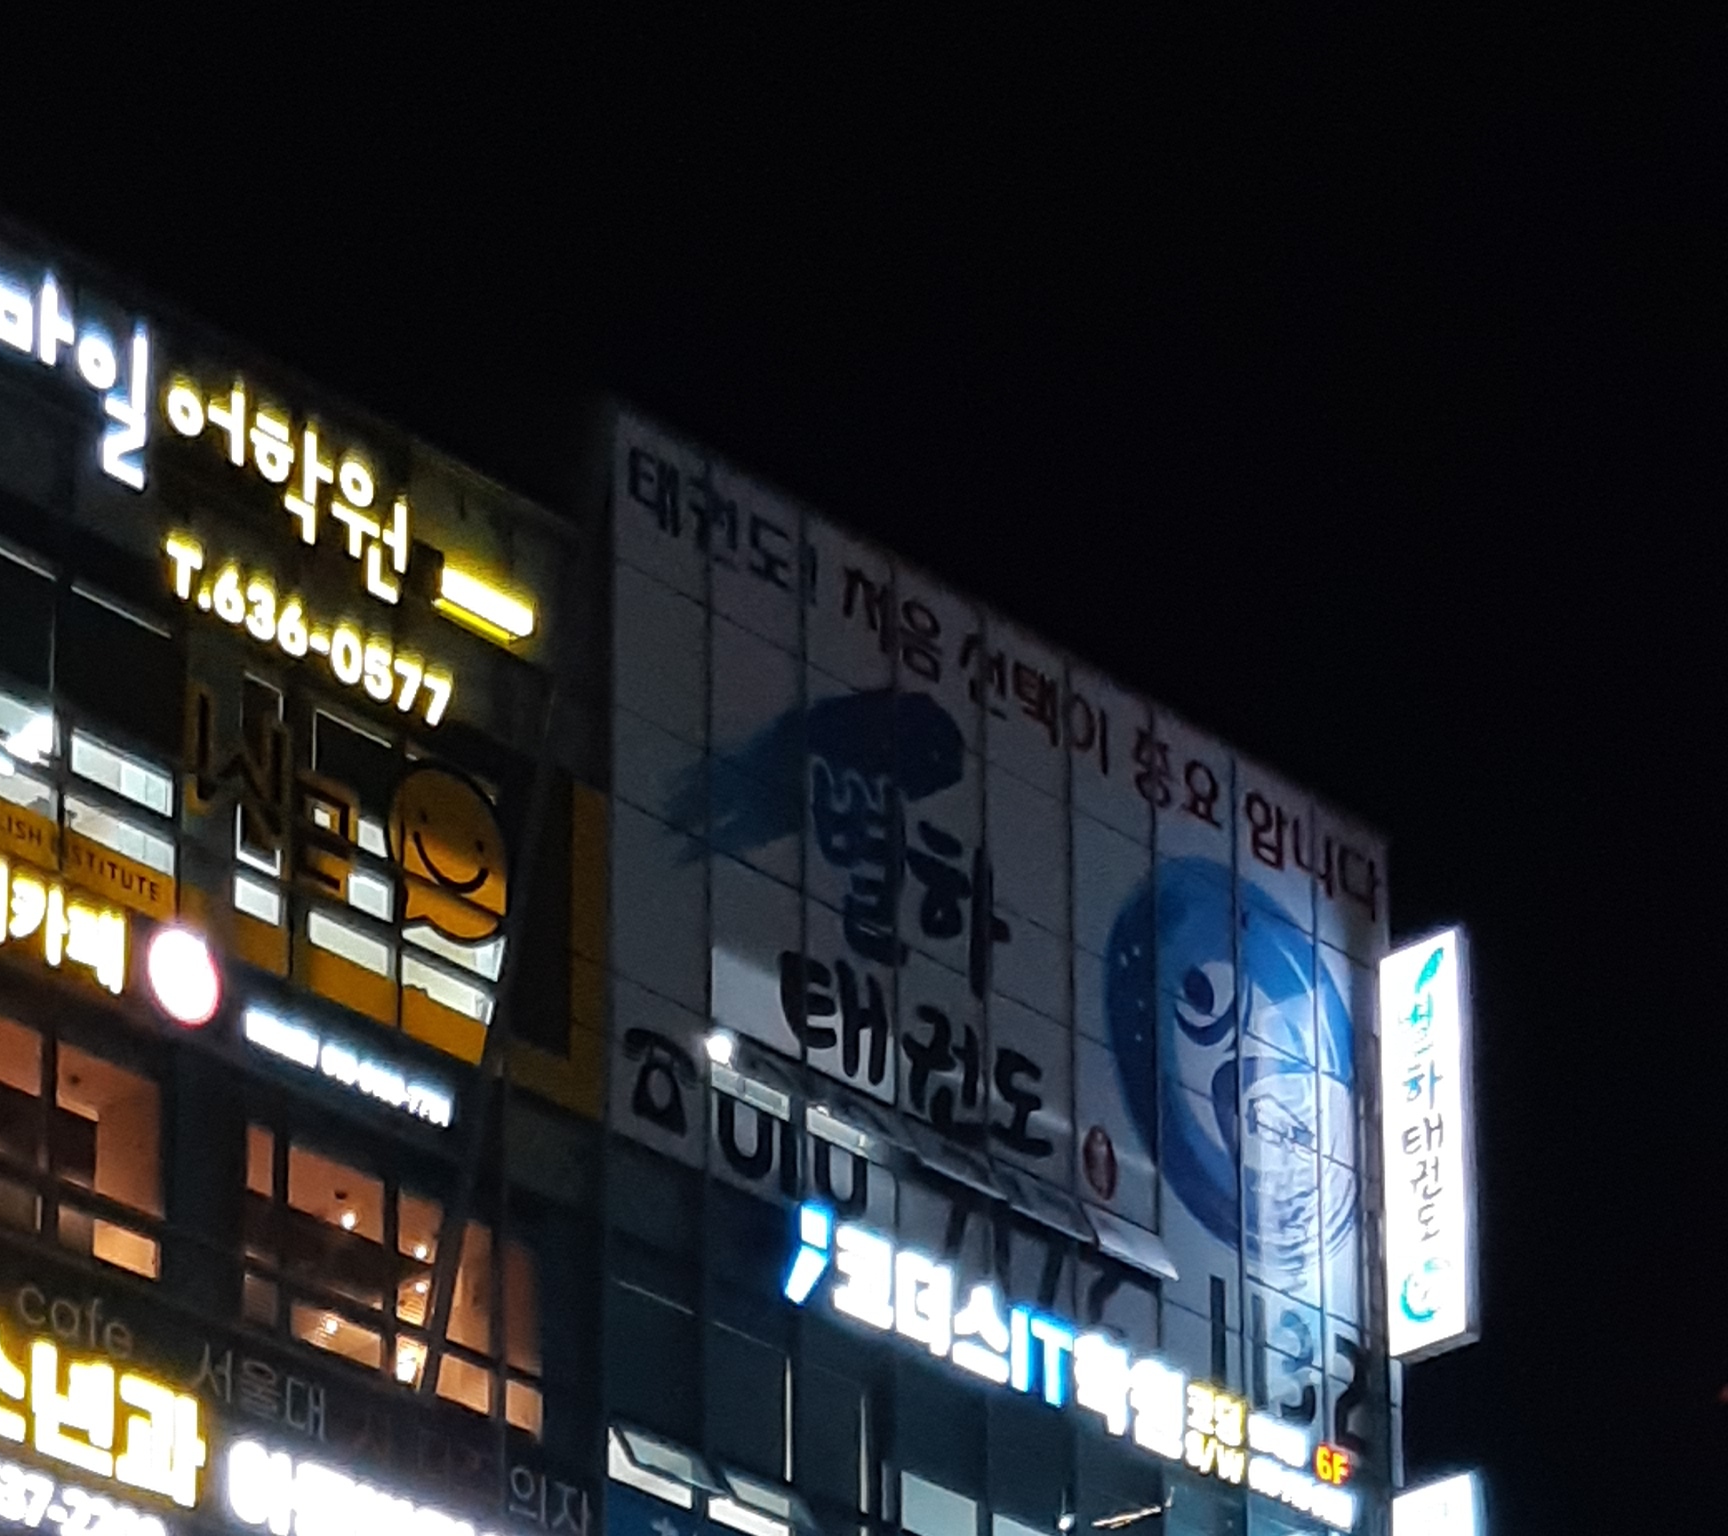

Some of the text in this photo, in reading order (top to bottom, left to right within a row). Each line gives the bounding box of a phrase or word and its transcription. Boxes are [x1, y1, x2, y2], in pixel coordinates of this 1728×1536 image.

[166, 375, 409, 604] 어학원
[166, 531, 454, 726] T.636-0577
[14, 1284, 136, 1354] cafe
[194, 1342, 327, 1442] 서울대
[1315, 1442, 1351, 1486] 6F
